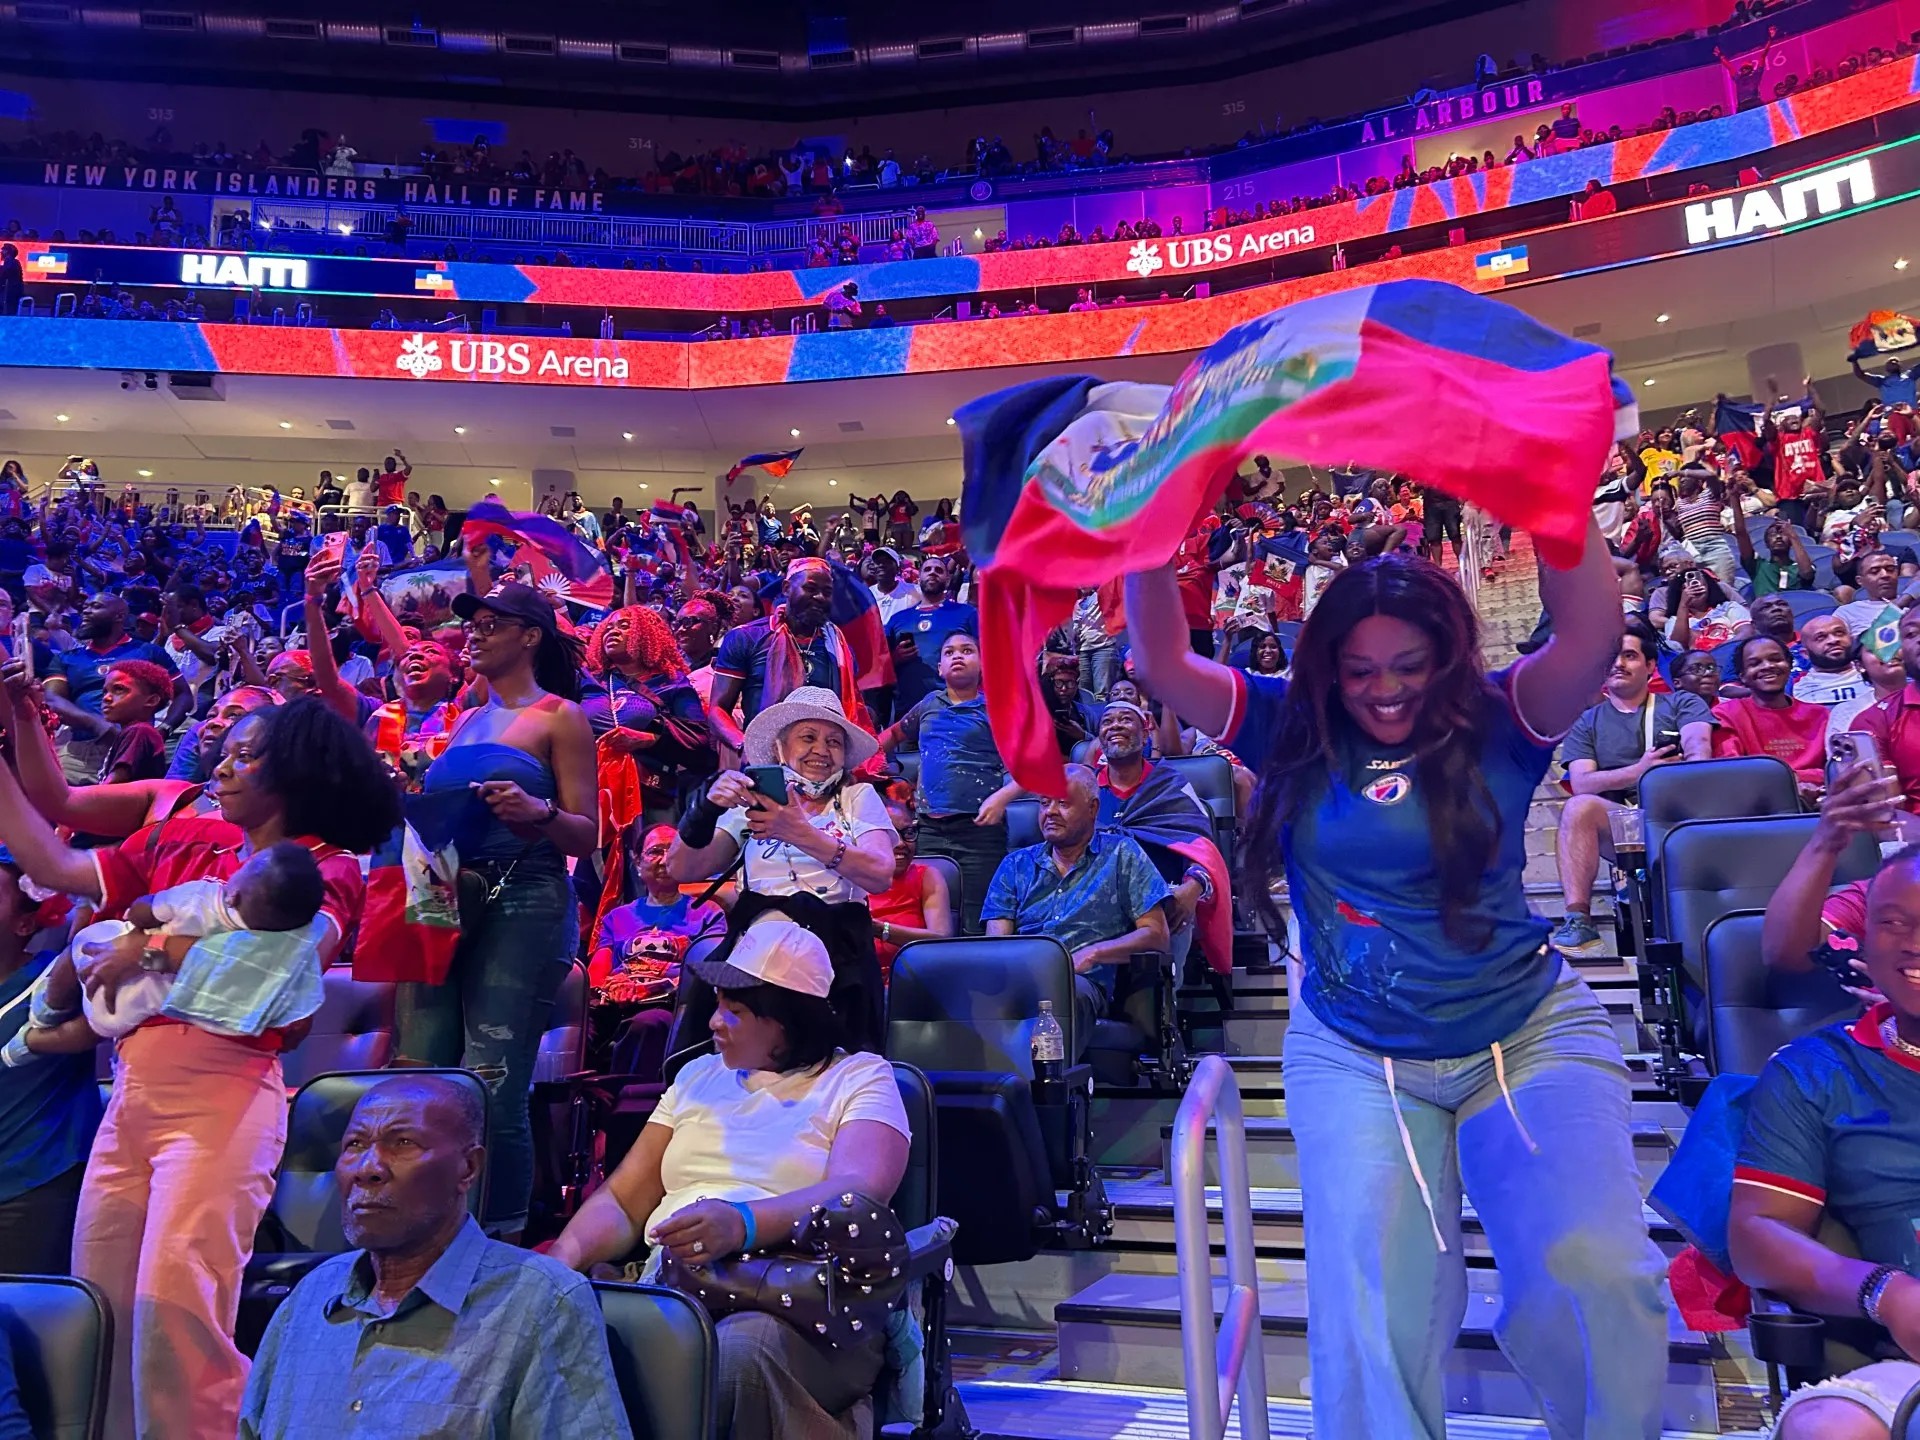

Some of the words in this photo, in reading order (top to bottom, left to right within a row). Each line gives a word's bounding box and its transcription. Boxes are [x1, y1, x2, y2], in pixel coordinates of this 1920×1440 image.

[148, 109, 174, 121] 313
[1222, 101, 1245, 116] 315
[1361, 117, 1394, 143] AL
[1415, 80, 1543, 130] ARBOUR
[628, 137, 652, 149] 314
[44, 163, 107, 186] NEW
[124, 167, 198, 191] YORK
[215, 171, 375, 200] ISLANDERS
[404, 182, 471, 205] HALL
[488, 187, 518, 207] OF
[535, 189, 603, 212] FAME
[1224, 180, 1255, 201] 215
[1684, 158, 1876, 245] HAITI
[1166, 233, 1234, 269] UBS
[1239, 225, 1315, 257] Arena
[181, 253, 307, 289] HAITI
[449, 339, 531, 375] UBS
[537, 350, 629, 379] Arena
